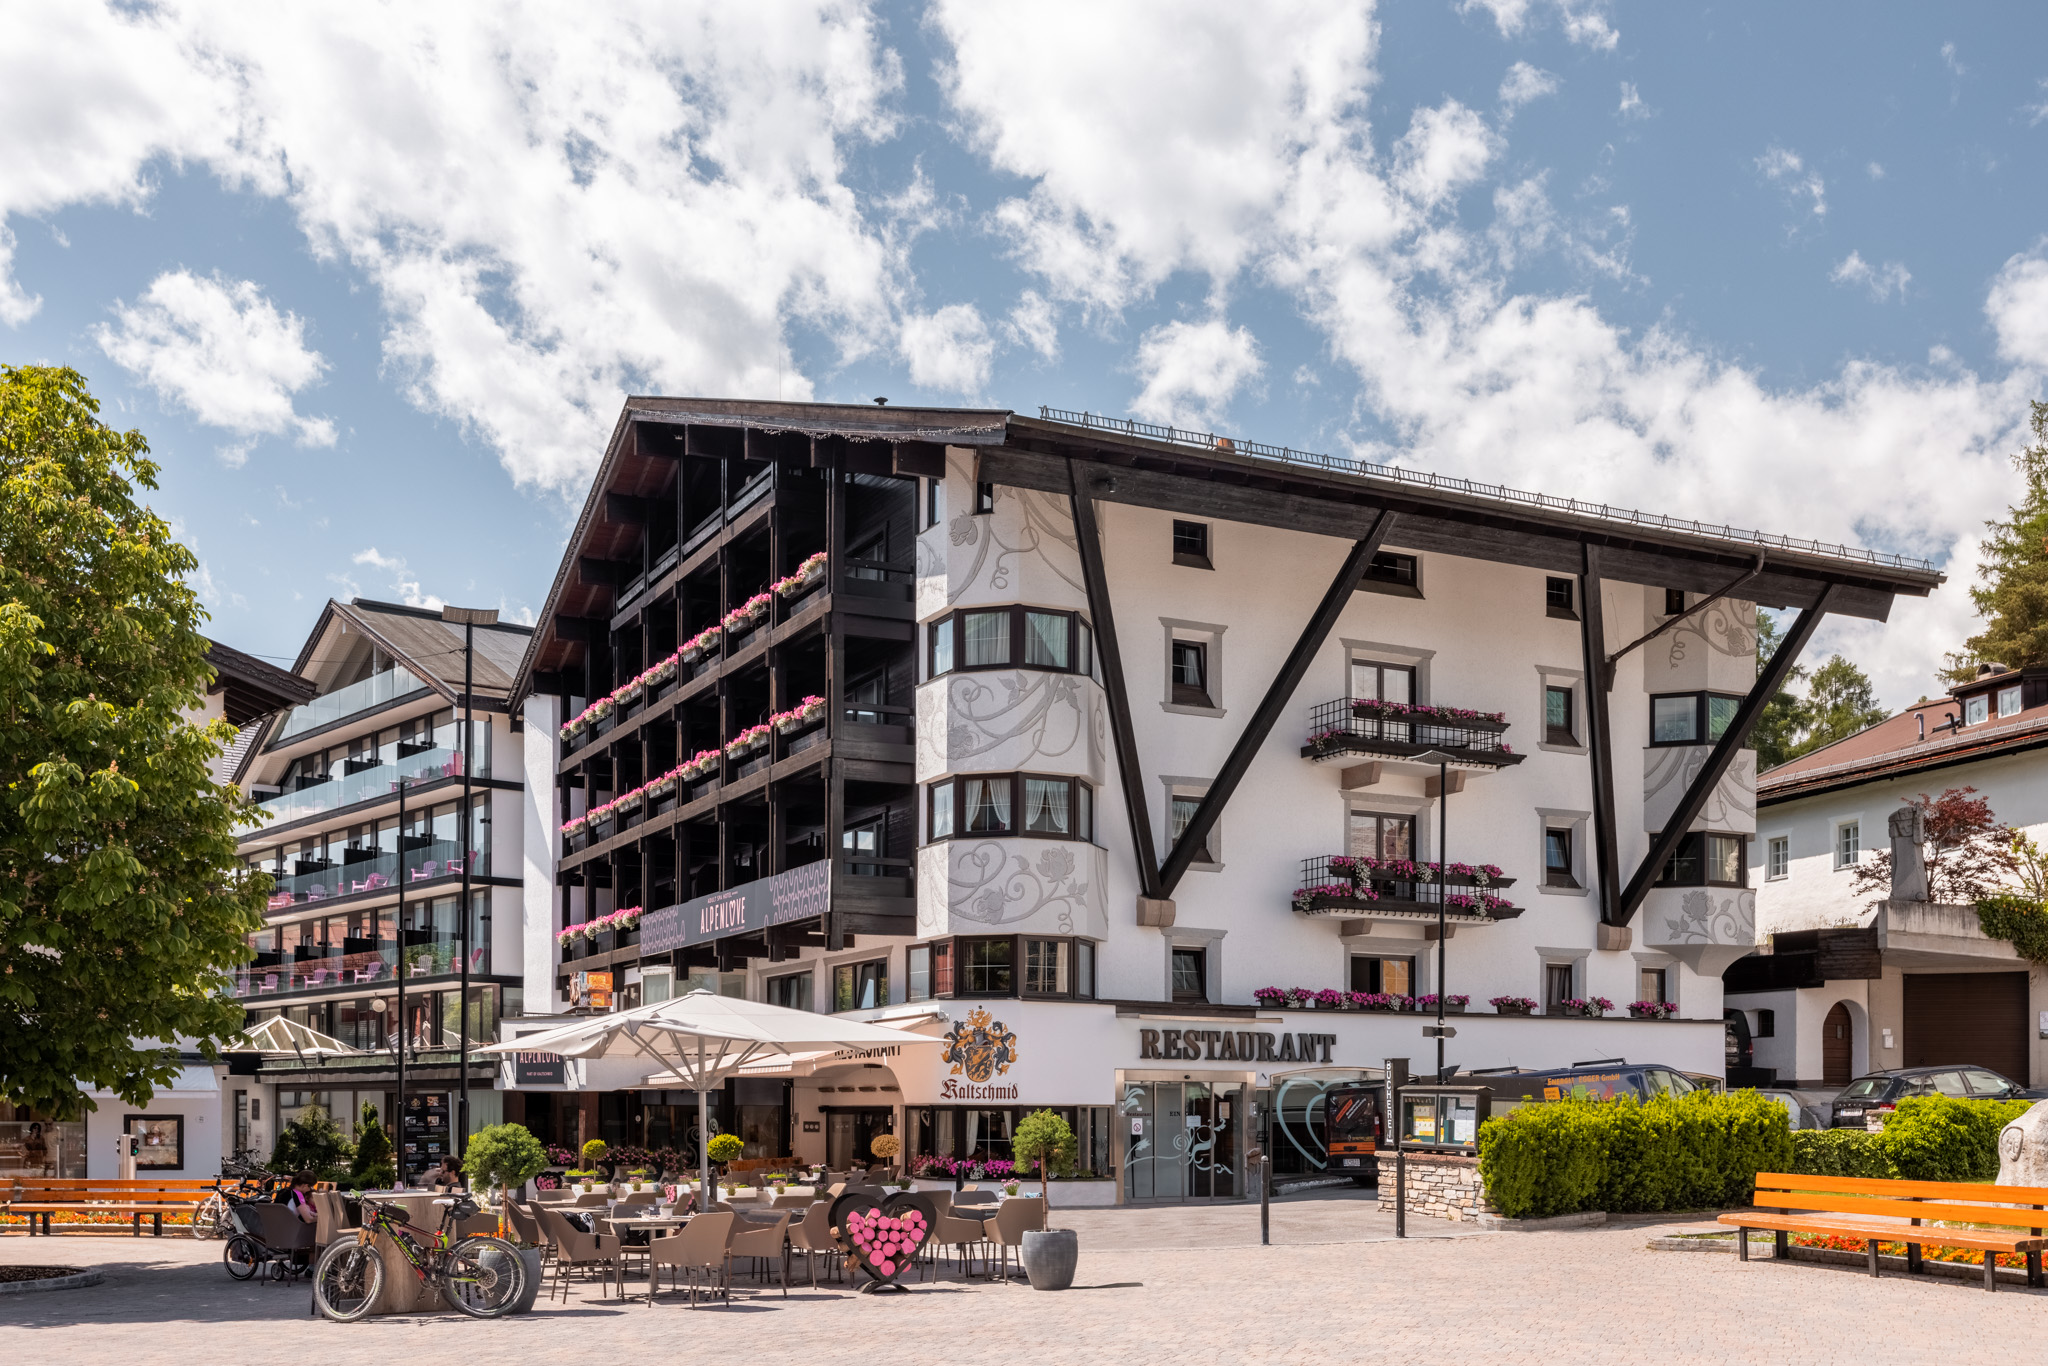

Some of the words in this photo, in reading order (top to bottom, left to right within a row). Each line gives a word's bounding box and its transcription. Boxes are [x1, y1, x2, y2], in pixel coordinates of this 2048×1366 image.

[700, 896, 746, 935] ALPENLOVE
[834, 1045, 901, 1061] SAURANT
[1139, 1028, 1337, 1063] RESTAURANT
[940, 1078, 1019, 1102] Kaltschmid
[1578, 1075, 1600, 1083] EGGER
[1601, 1073, 1620, 1082] GmbH
